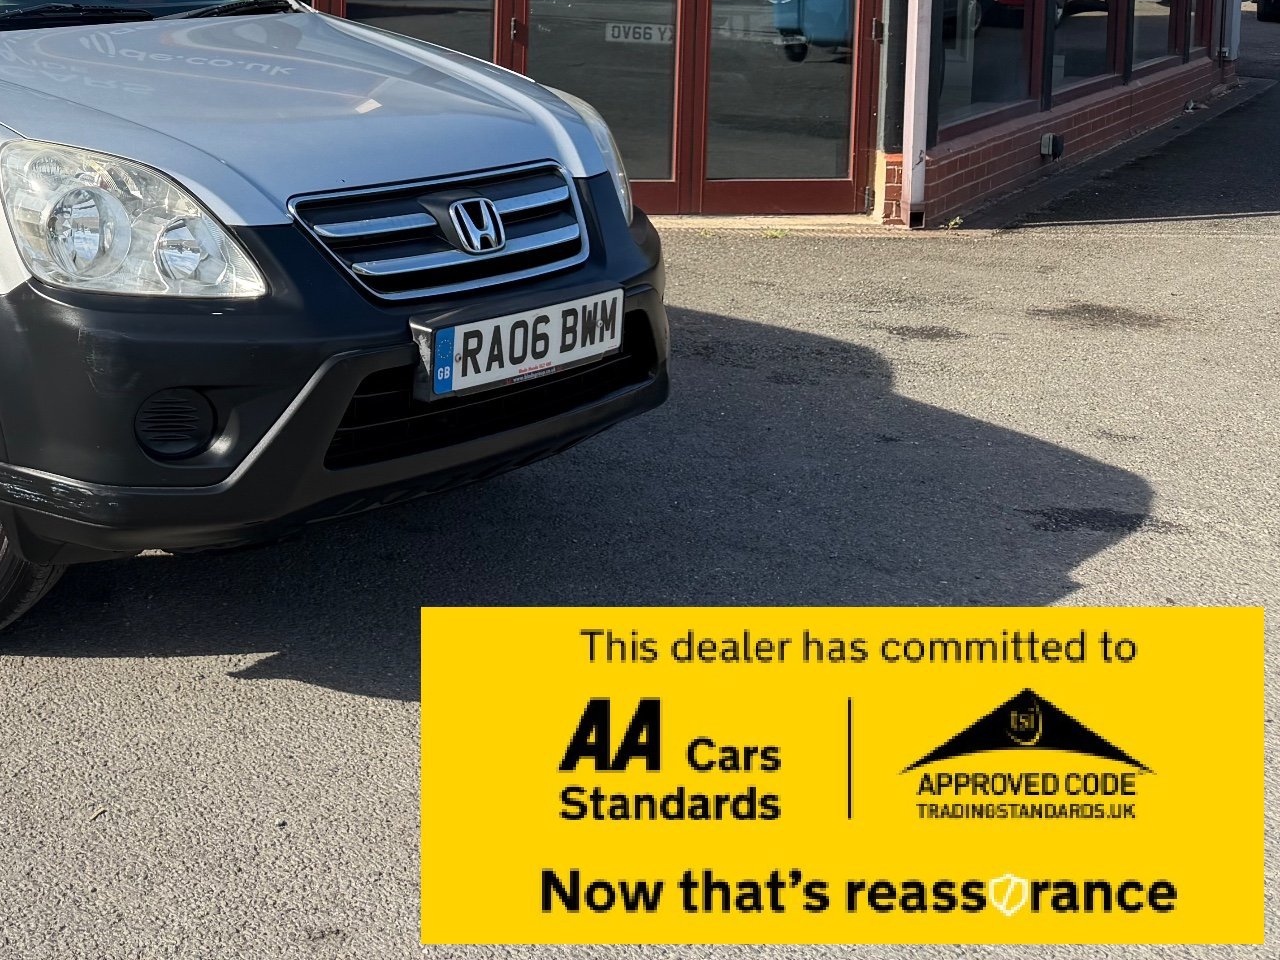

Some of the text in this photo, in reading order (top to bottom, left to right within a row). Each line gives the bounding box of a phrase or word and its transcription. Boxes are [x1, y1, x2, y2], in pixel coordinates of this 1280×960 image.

[611, 25, 653, 41] OV66
[460, 296, 618, 378] RA06 BWM
[437, 365, 451, 381] GB
